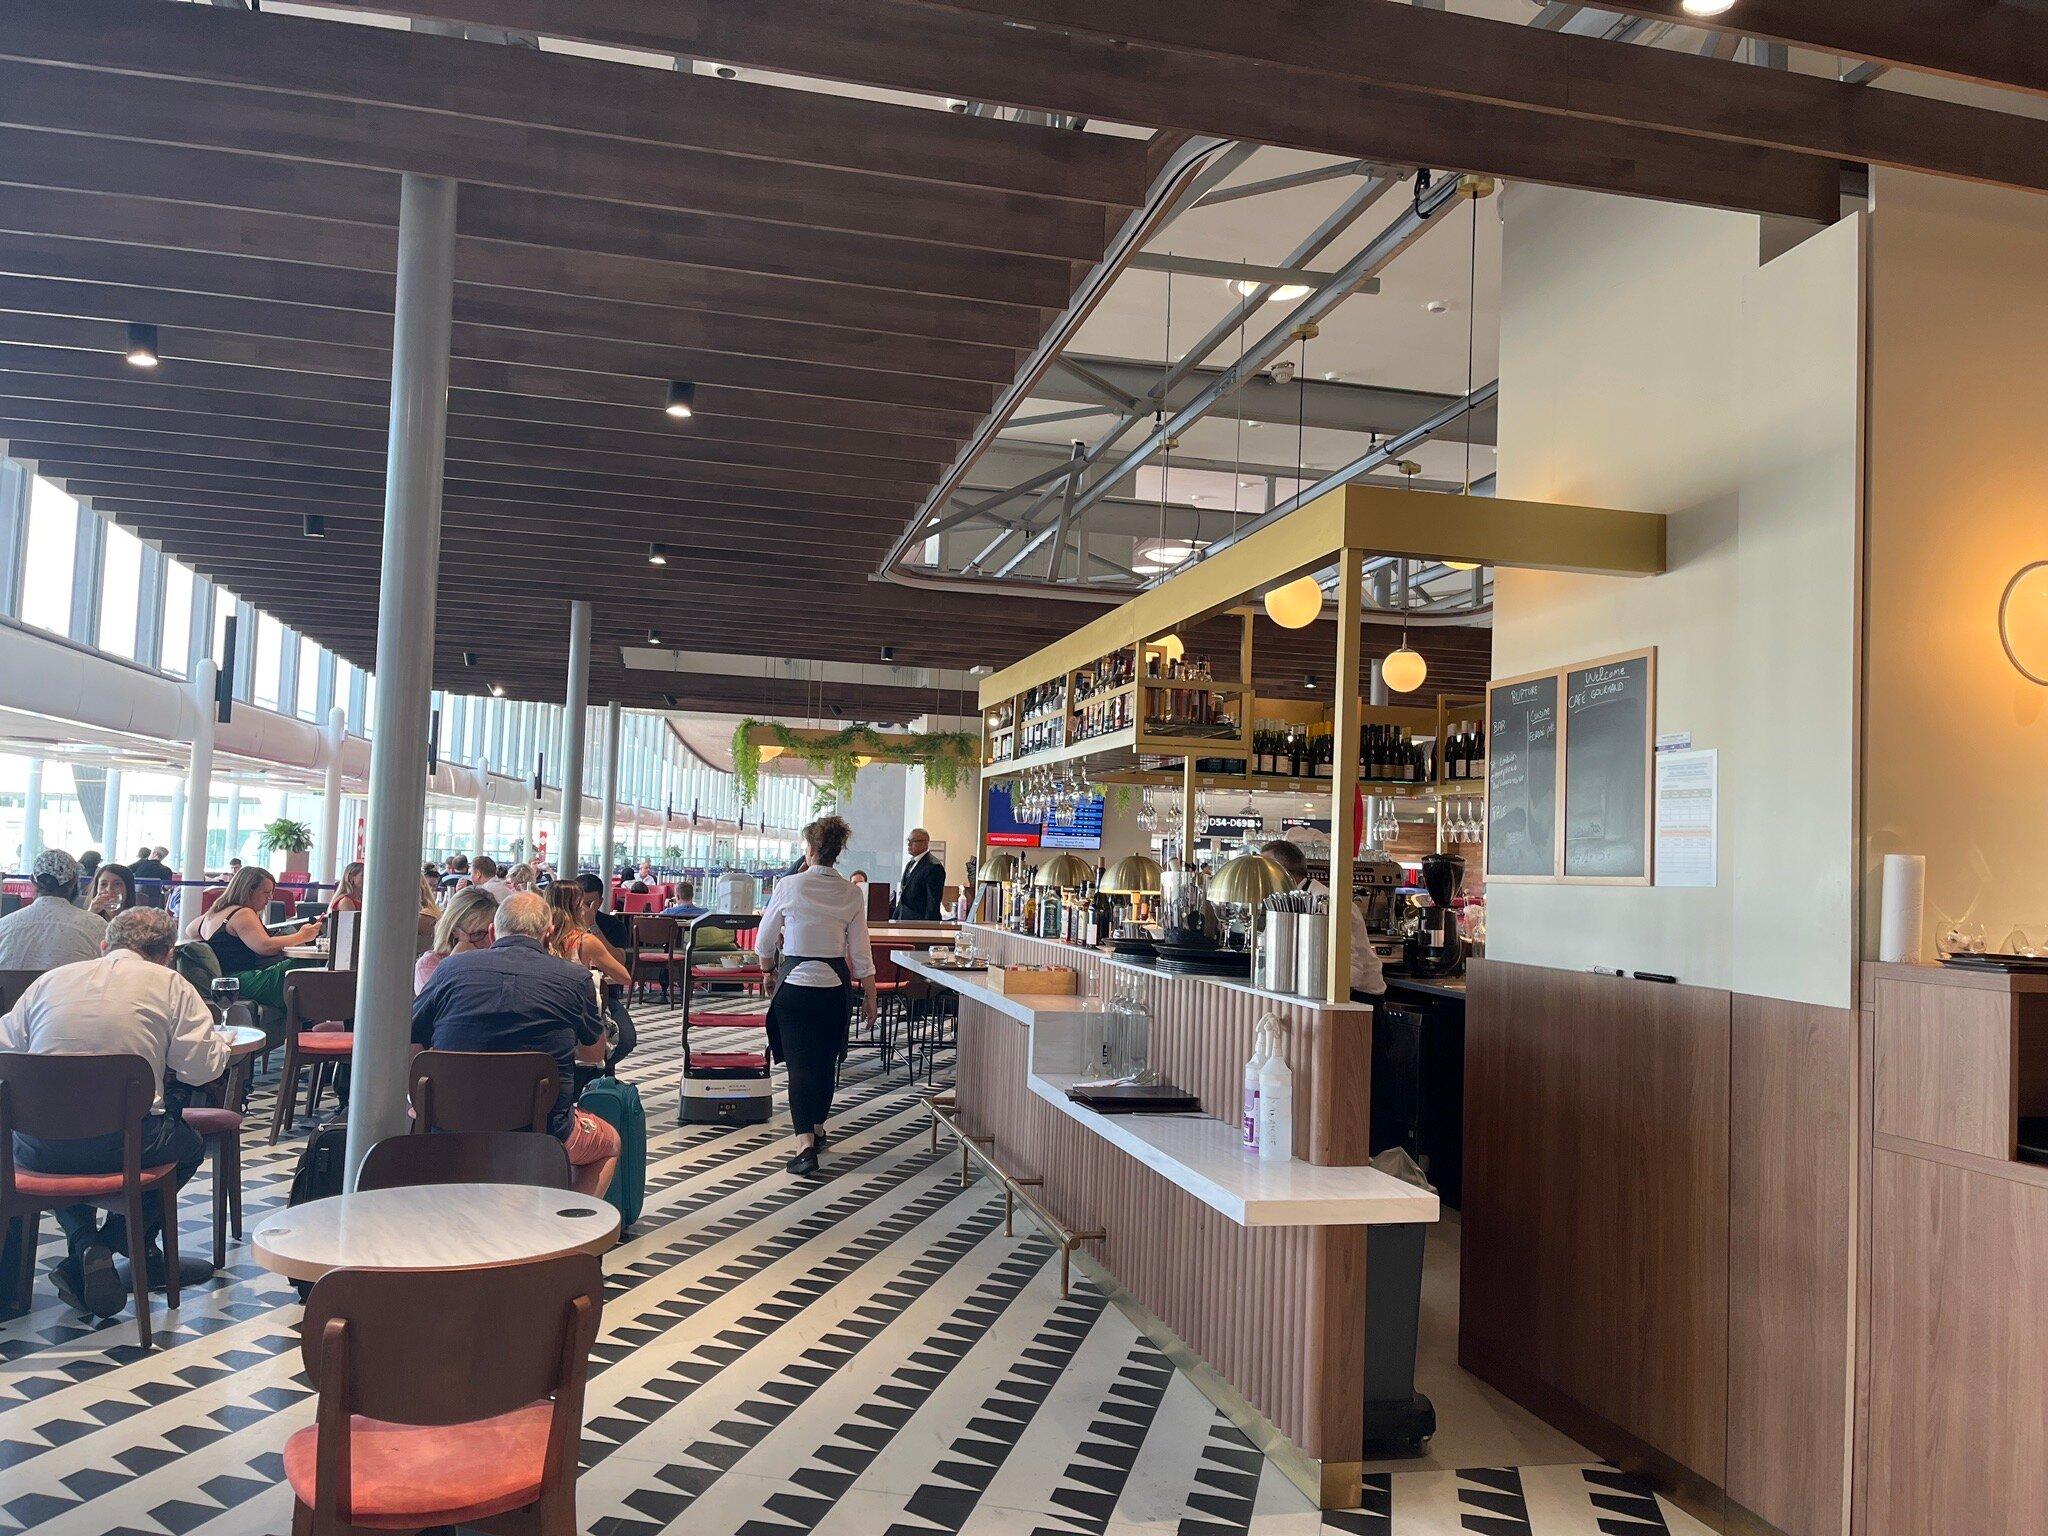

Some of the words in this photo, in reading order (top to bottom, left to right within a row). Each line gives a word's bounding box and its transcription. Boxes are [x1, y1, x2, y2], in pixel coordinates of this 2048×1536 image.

[1585, 666, 1626, 684] Welcome
[1511, 685, 1538, 703] RUPTURE
[1591, 681, 1624, 698] GOURMAND
[1492, 720, 1506, 733] BAR
[1209, 817, 1247, 828] D54-D69
